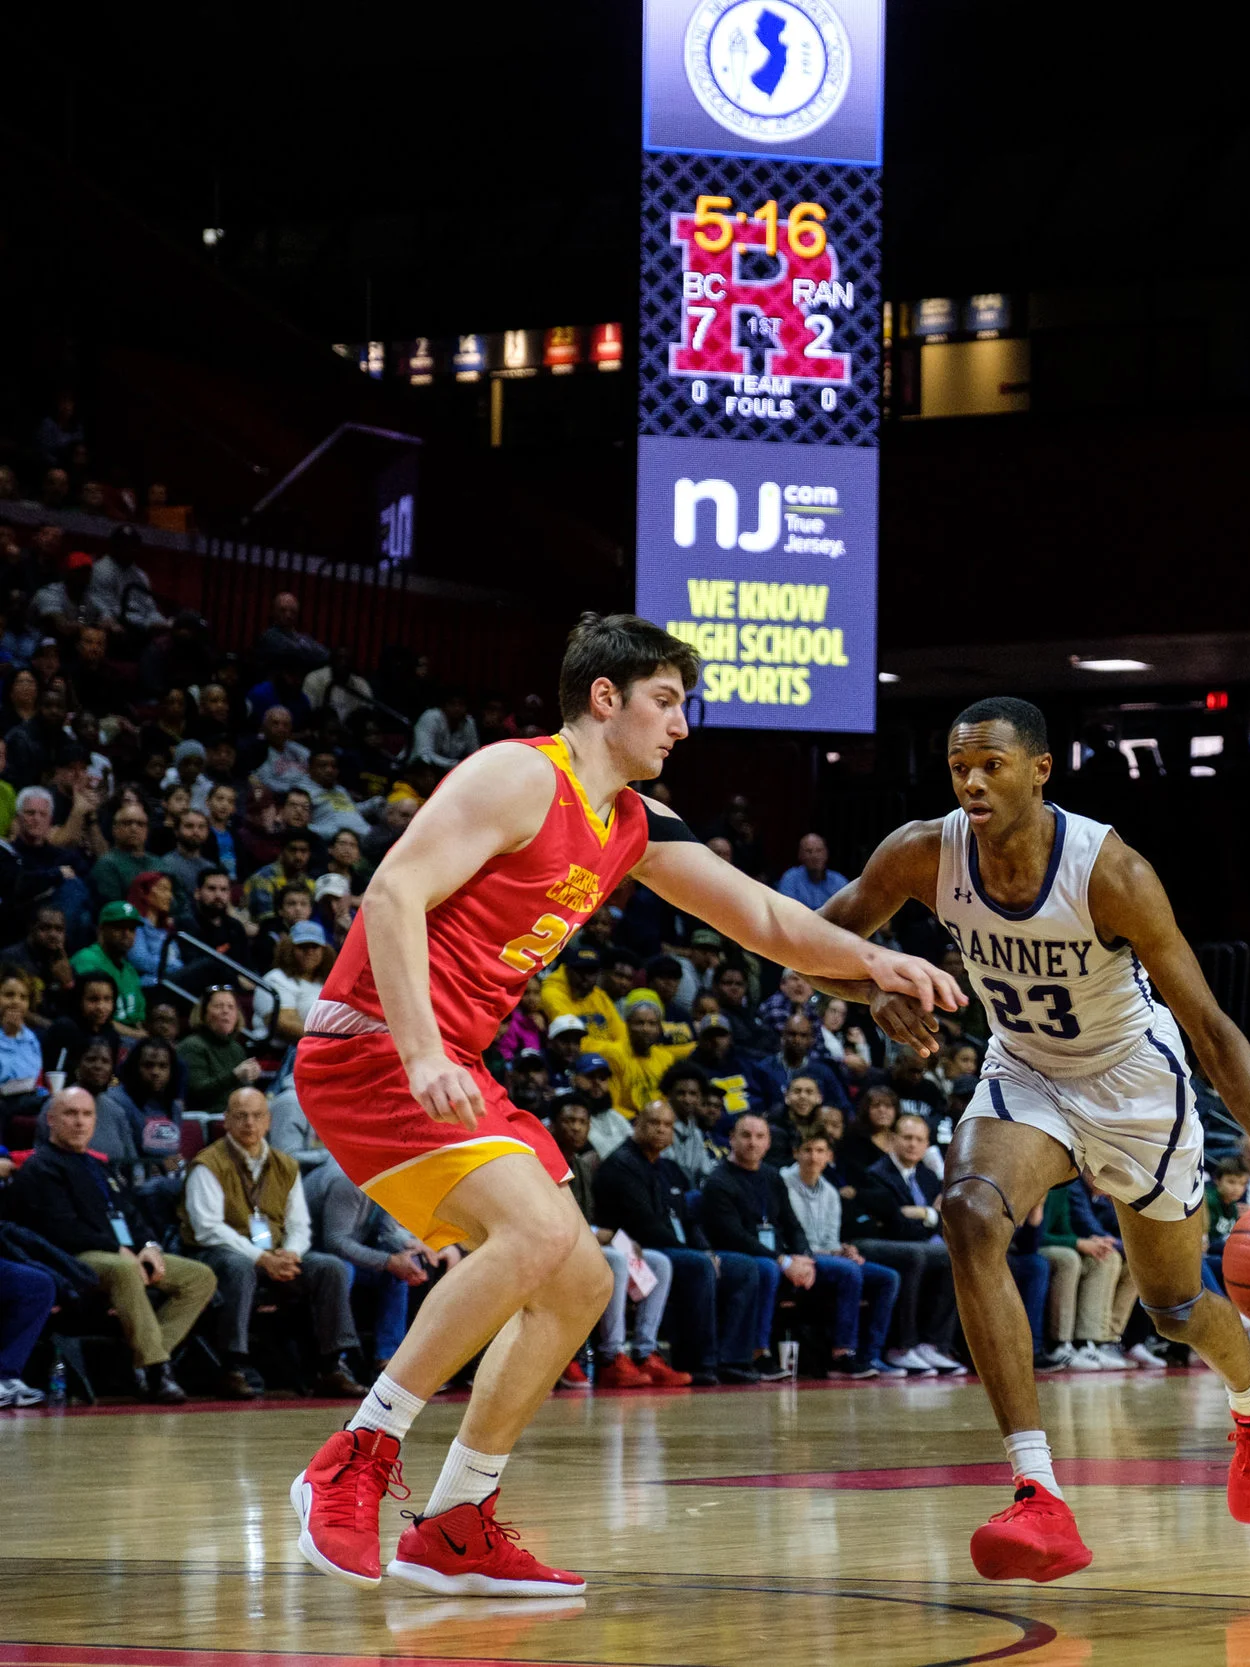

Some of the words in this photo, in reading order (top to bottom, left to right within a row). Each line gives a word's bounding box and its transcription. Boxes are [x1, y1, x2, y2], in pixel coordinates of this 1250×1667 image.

[694, 195, 828, 259] 5:16
[683, 271, 727, 301] BC
[792, 278, 854, 310] RAN
[686, 306, 717, 351] 7
[747, 316, 784, 336] 1ST
[803, 314, 834, 358] 2
[725, 396, 796, 420] FOULS
[731, 375, 792, 397] TEAM
[784, 513, 825, 535] True
[687, 578, 736, 619] WE
[738, 581, 829, 623] KNOW
[738, 623, 849, 667] SCHOOL
[702, 663, 812, 706] SPORTS
[499, 912, 582, 974] 2
[944, 919, 1093, 978] RANNEY
[981, 976, 1081, 1040] 23
